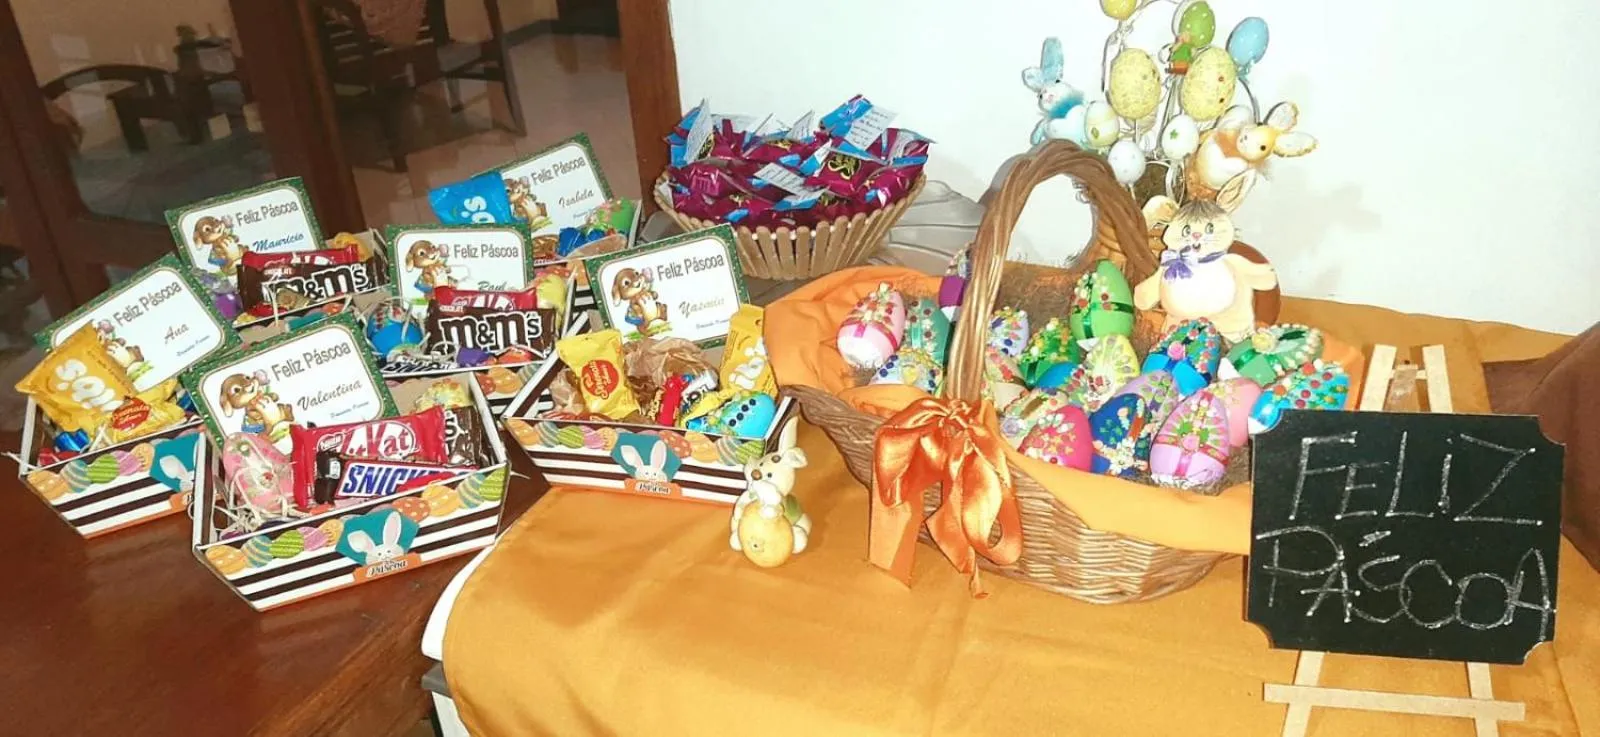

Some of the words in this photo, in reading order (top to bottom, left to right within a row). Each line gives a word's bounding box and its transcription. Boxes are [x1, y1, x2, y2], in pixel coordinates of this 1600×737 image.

[530, 169, 554, 186] Feliz
[552, 155, 586, 178] Páscoa
[235, 206, 262, 227] Feliz
[260, 200, 299, 220] Páscoa
[453, 243, 480, 259] Feliz
[480, 242, 519, 259] Páscoa
[657, 261, 684, 281] Feliz
[684, 254, 725, 275] Páscoa
[113, 303, 144, 327] Feliz
[138, 280, 183, 311] Páscoa
[164, 323, 189, 344] Ana
[271, 359, 305, 382] Feliz
[302, 341, 352, 368] Páscoa
[296, 379, 363, 412] Valentina
[1288, 430, 1543, 527] FELIZ
[1255, 526, 1557, 641] PÁSCOA
